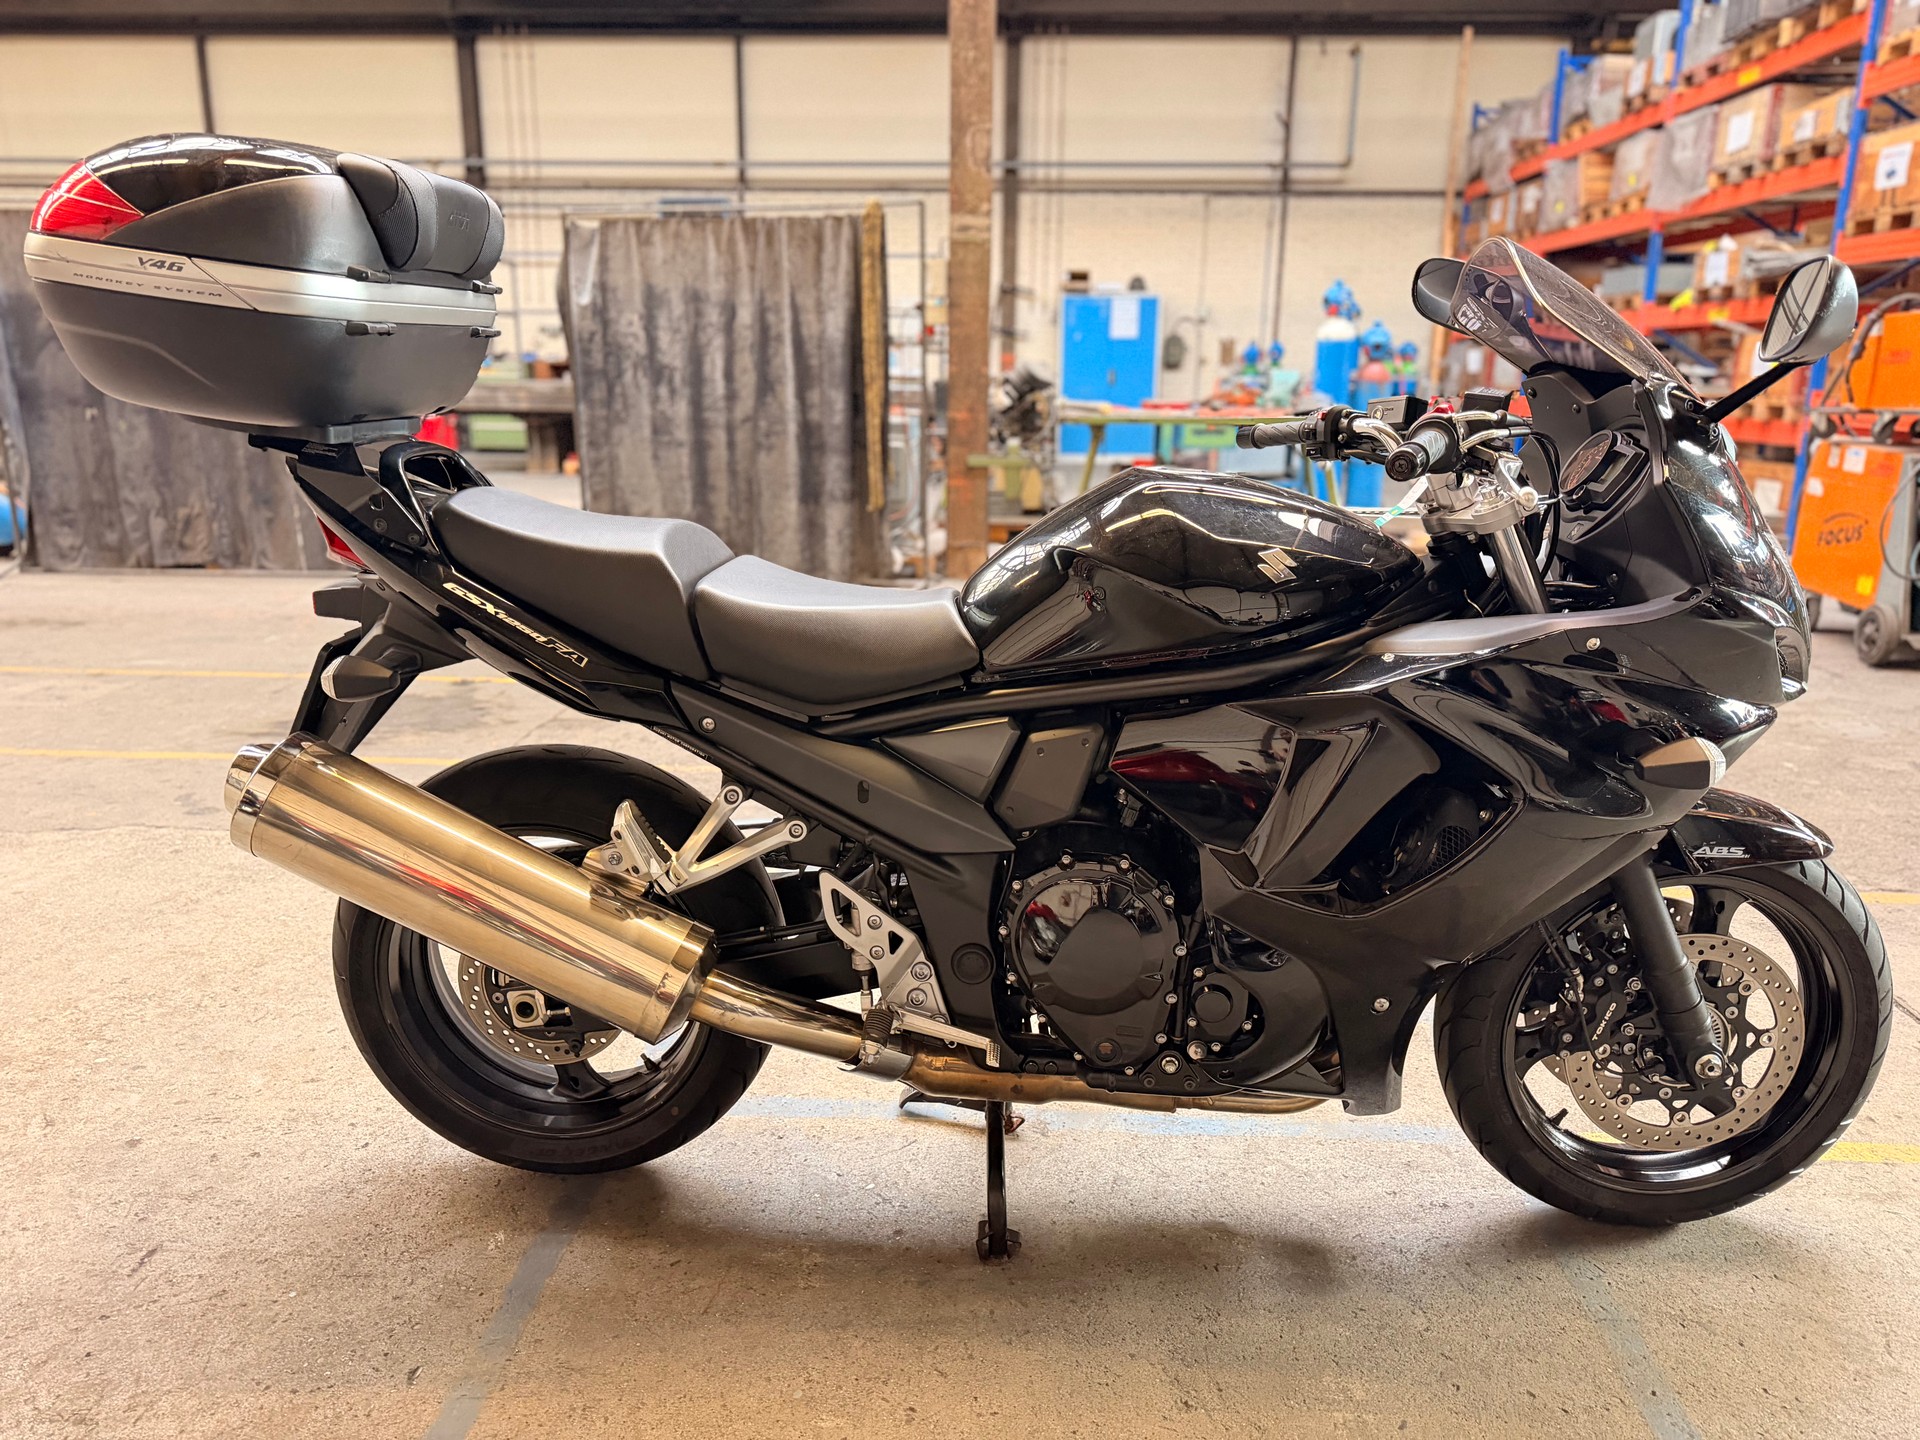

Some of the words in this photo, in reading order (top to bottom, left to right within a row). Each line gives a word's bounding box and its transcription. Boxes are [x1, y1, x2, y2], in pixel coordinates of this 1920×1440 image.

[138, 256, 186, 272] V46
[73, 272, 145, 287] MONOKEY
[153, 285, 223, 297] SYSTEM
[1817, 524, 1863, 546] FOCUS
[1692, 846, 1746, 856] ABS
[1592, 1002, 1617, 1041] TOKICO
